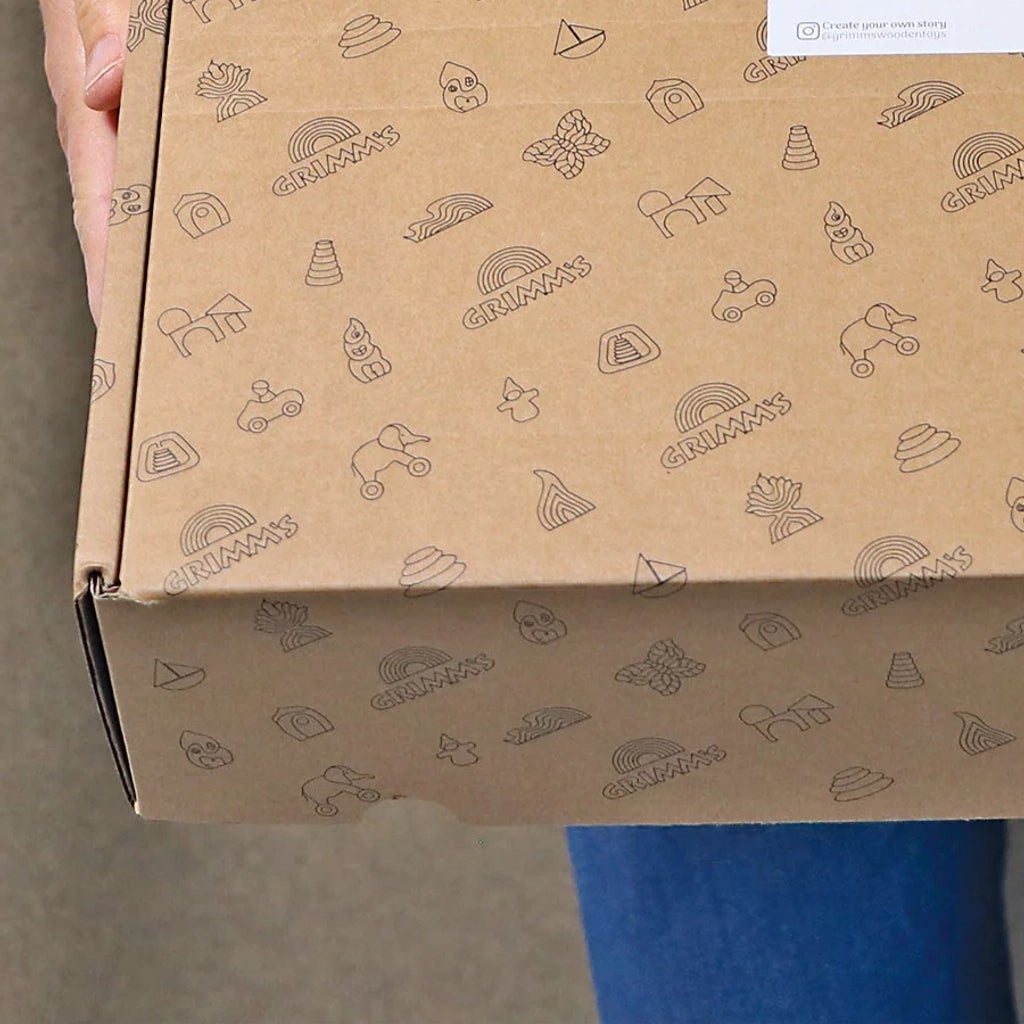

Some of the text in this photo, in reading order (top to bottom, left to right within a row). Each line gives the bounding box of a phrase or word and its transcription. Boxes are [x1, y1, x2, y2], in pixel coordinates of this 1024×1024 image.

[822, 21, 859, 29] Create
[862, 22, 888, 30] your
[918, 20, 947, 29] story
[272, 124, 400, 196] GRIMM'S
[462, 255, 592, 330] GRIMM'S
[660, 392, 792, 468] GRIMM'S
[163, 514, 299, 596] GRIMM'S
[841, 544, 973, 618] GRIMM'S
[370, 652, 495, 712] GRIMM'S
[601, 744, 727, 801] GRIMM'S
